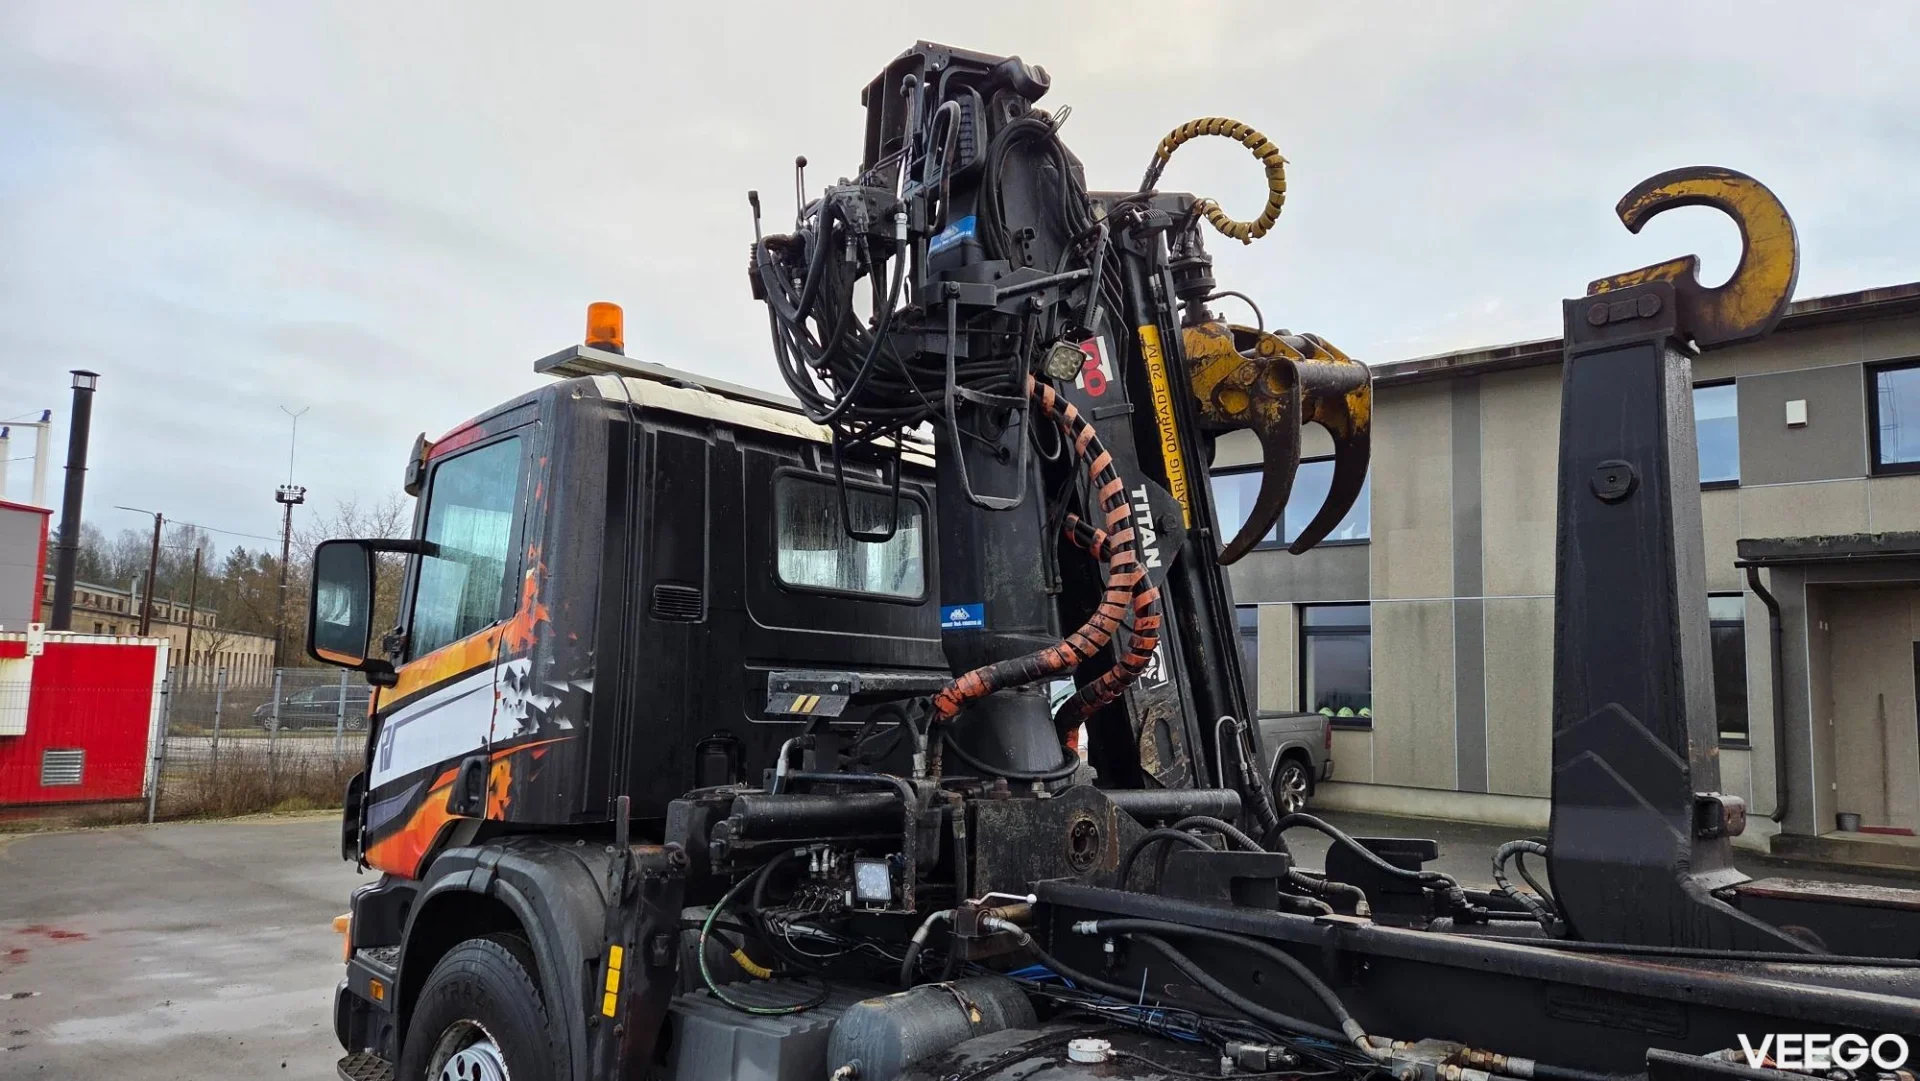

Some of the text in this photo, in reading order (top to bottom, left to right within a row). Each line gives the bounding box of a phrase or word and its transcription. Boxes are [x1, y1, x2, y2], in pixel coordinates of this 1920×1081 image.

[1147, 344, 1159, 358] M
[1151, 363, 1163, 379] 20
[1131, 484, 1162, 568] TITAN
